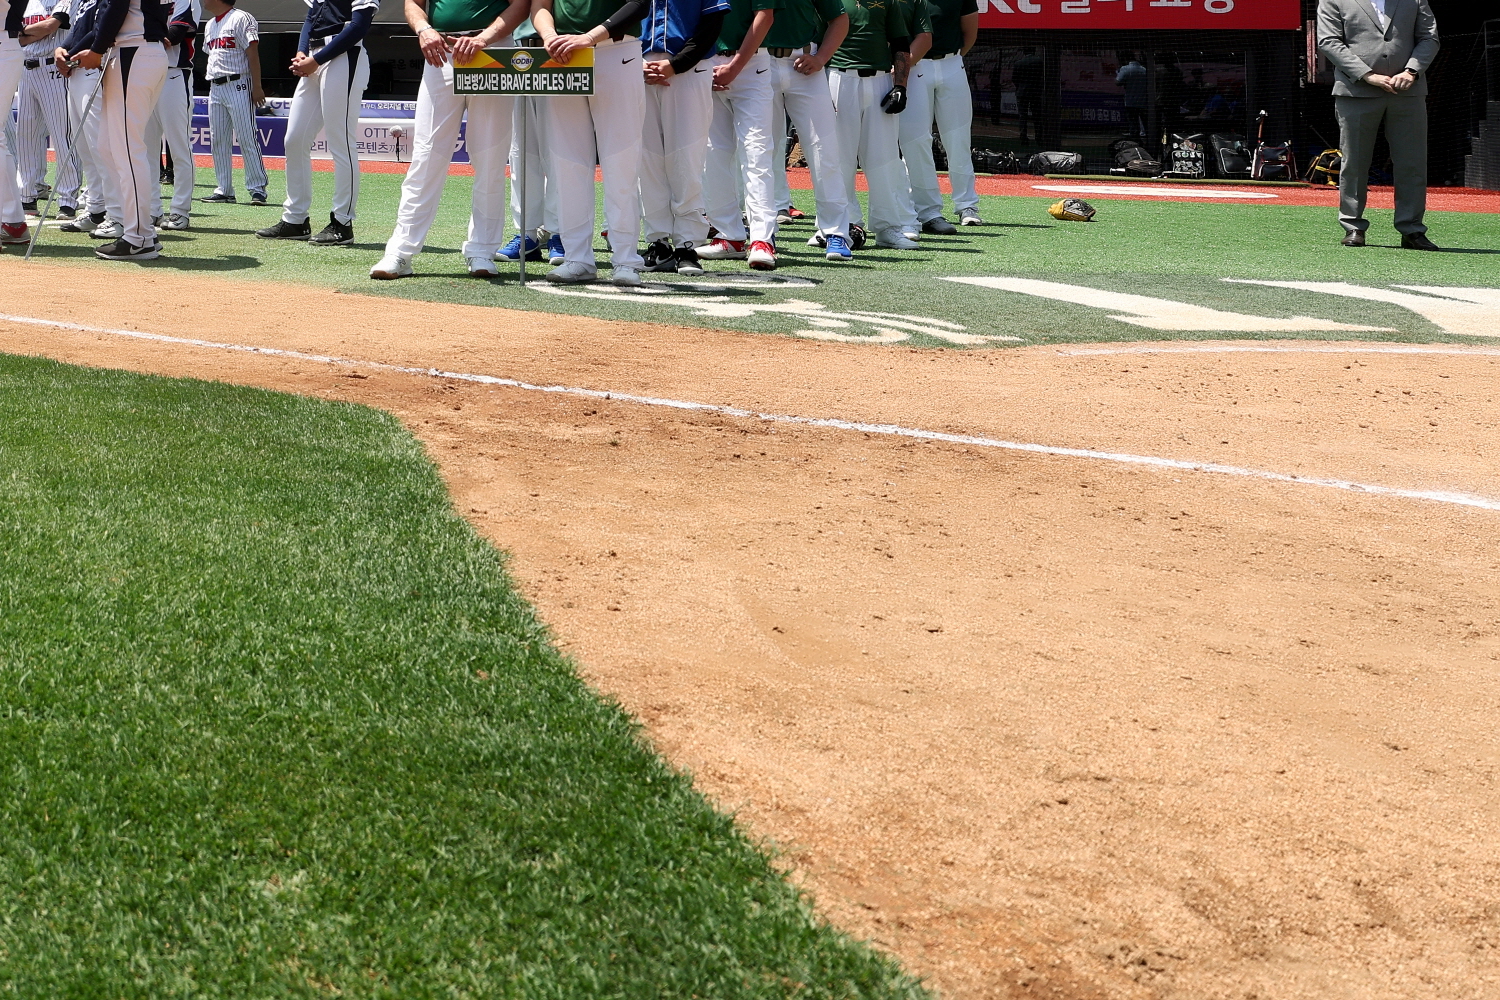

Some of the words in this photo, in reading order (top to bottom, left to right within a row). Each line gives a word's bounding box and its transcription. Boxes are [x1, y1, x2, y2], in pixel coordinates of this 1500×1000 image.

[50, 71, 61, 80] 72
[456, 73, 498, 91] 미보병2사단
[500, 74, 530, 91] BRAVE
[533, 74, 564, 91] RIFLES
[566, 72, 590, 91] 야구단
[236, 84, 247, 92] 99
[377, 102, 401, 111] 오리지널
[364, 127, 408, 138] OTT터
